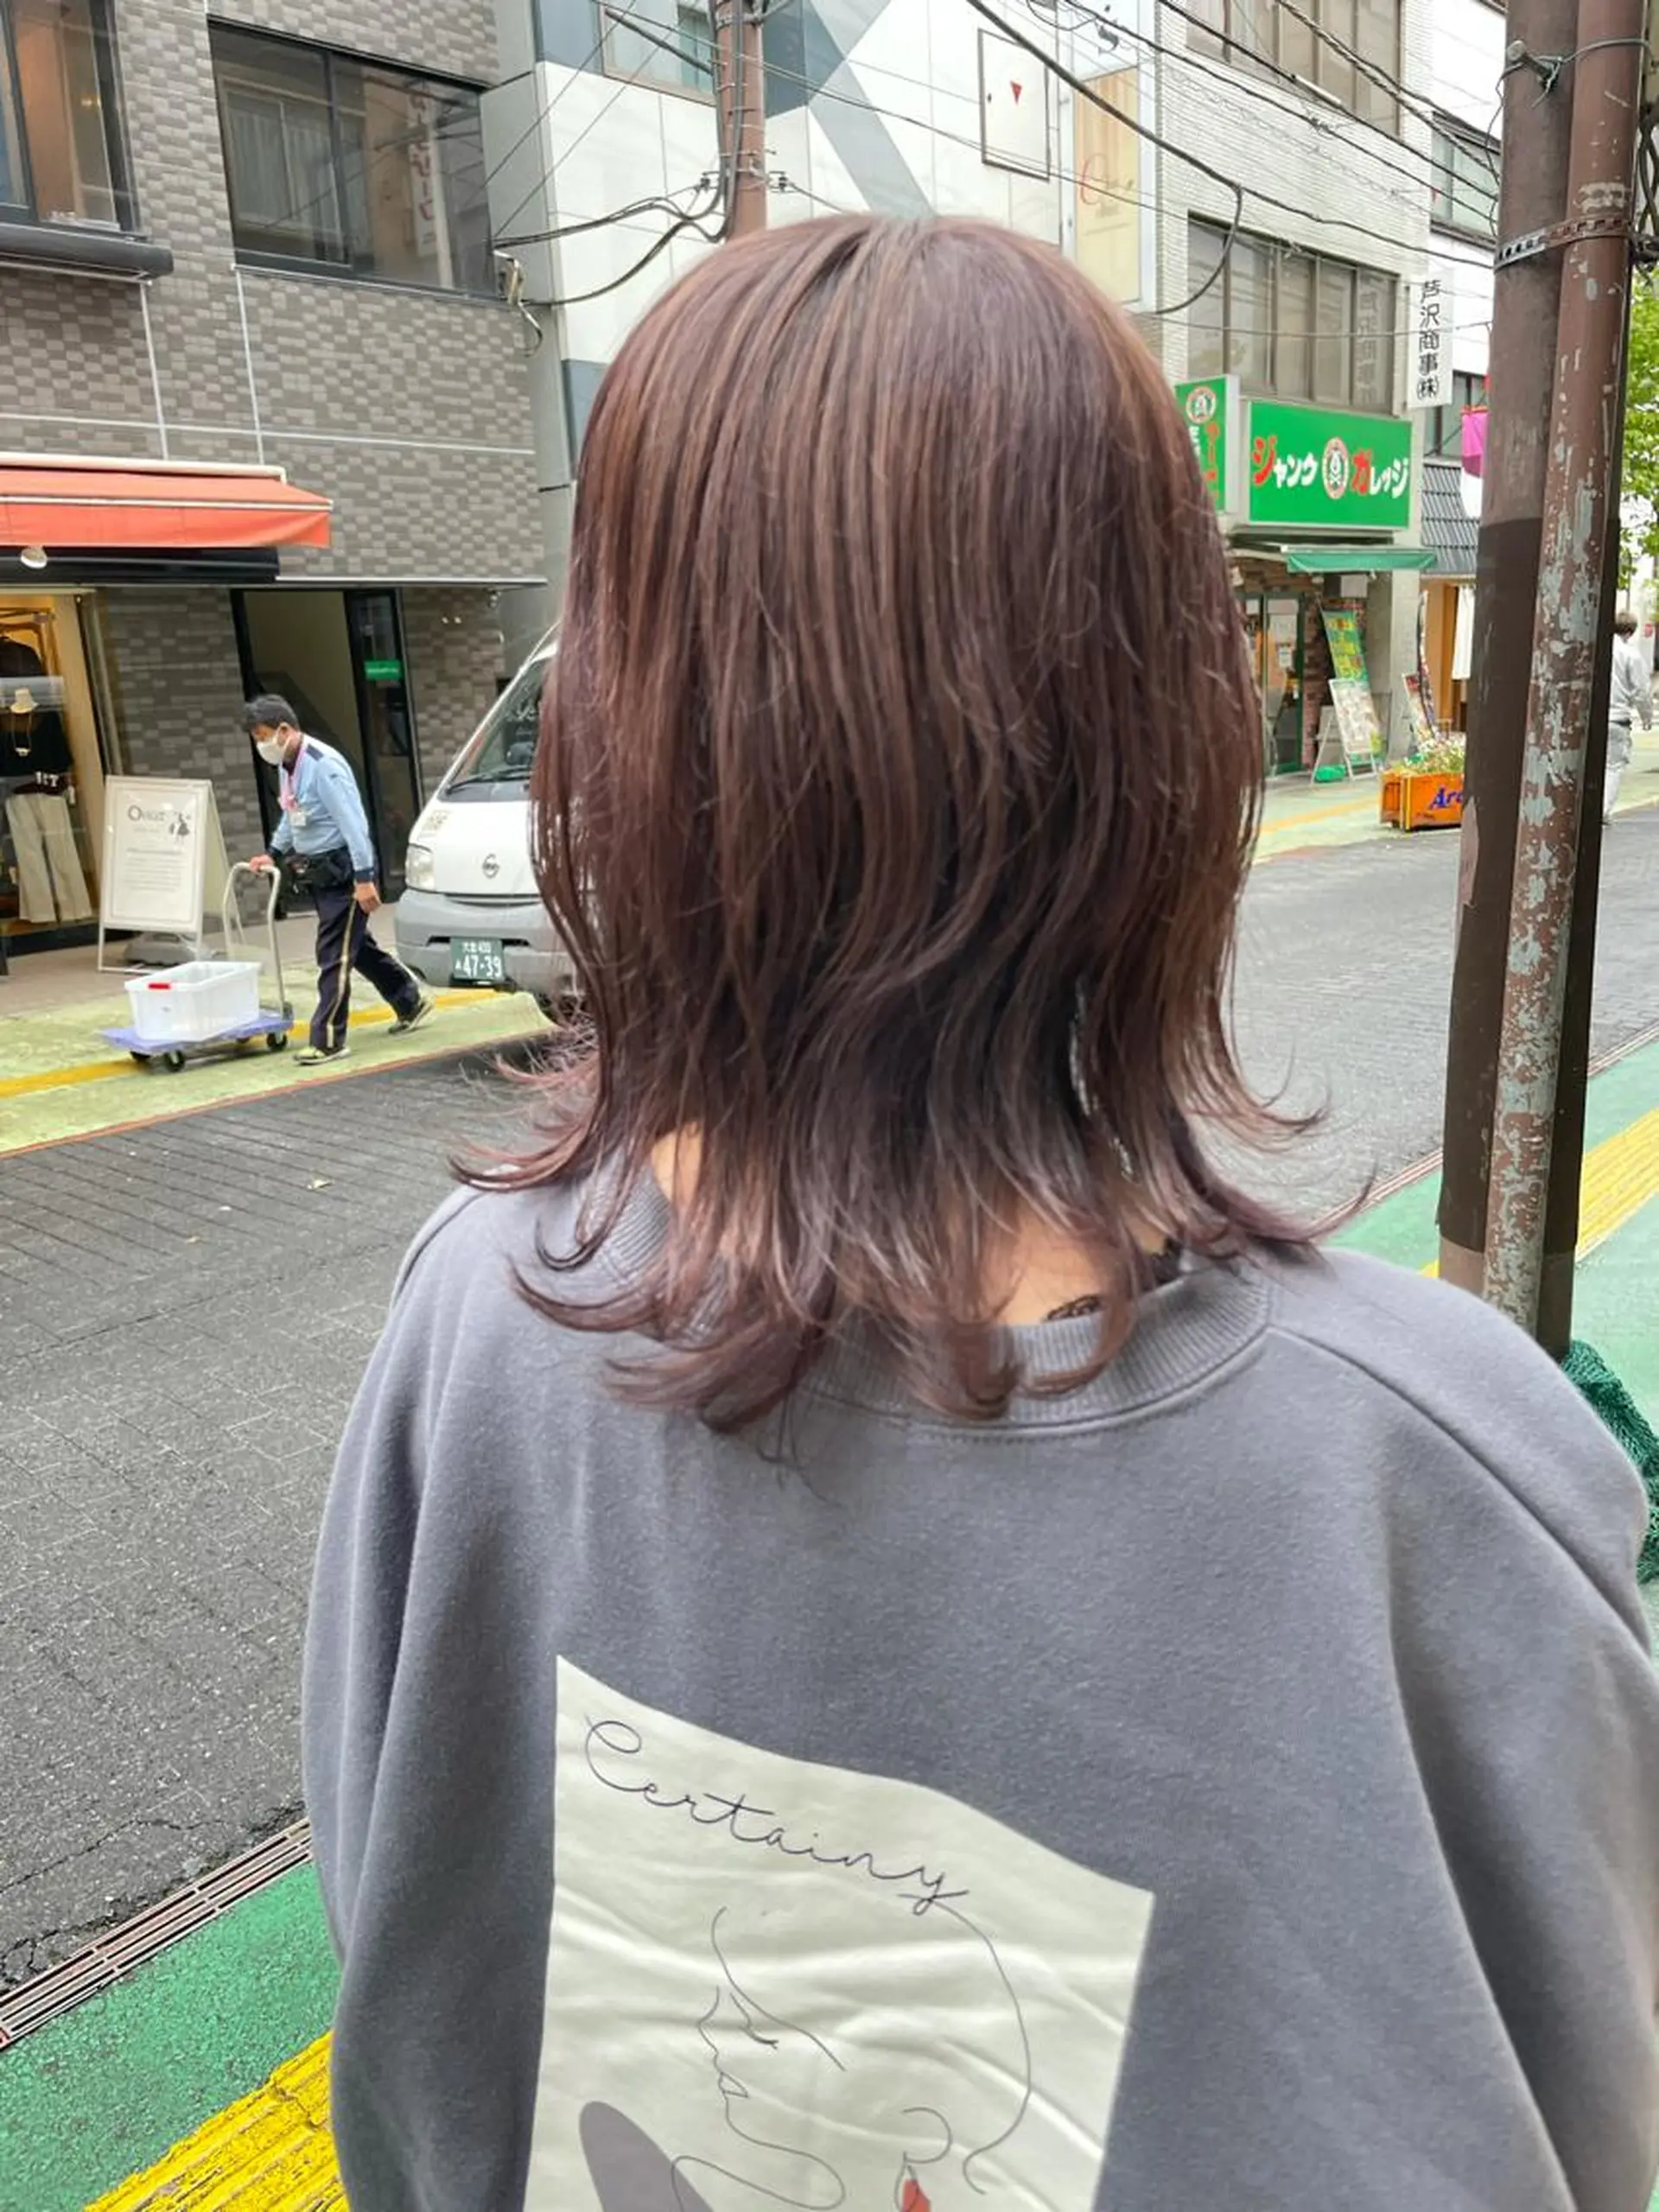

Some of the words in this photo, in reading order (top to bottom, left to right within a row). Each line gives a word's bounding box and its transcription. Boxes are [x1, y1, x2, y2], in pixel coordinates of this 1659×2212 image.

[1252, 435, 1319, 489] ジャンク
[1351, 448, 1409, 499] ガレッジ
